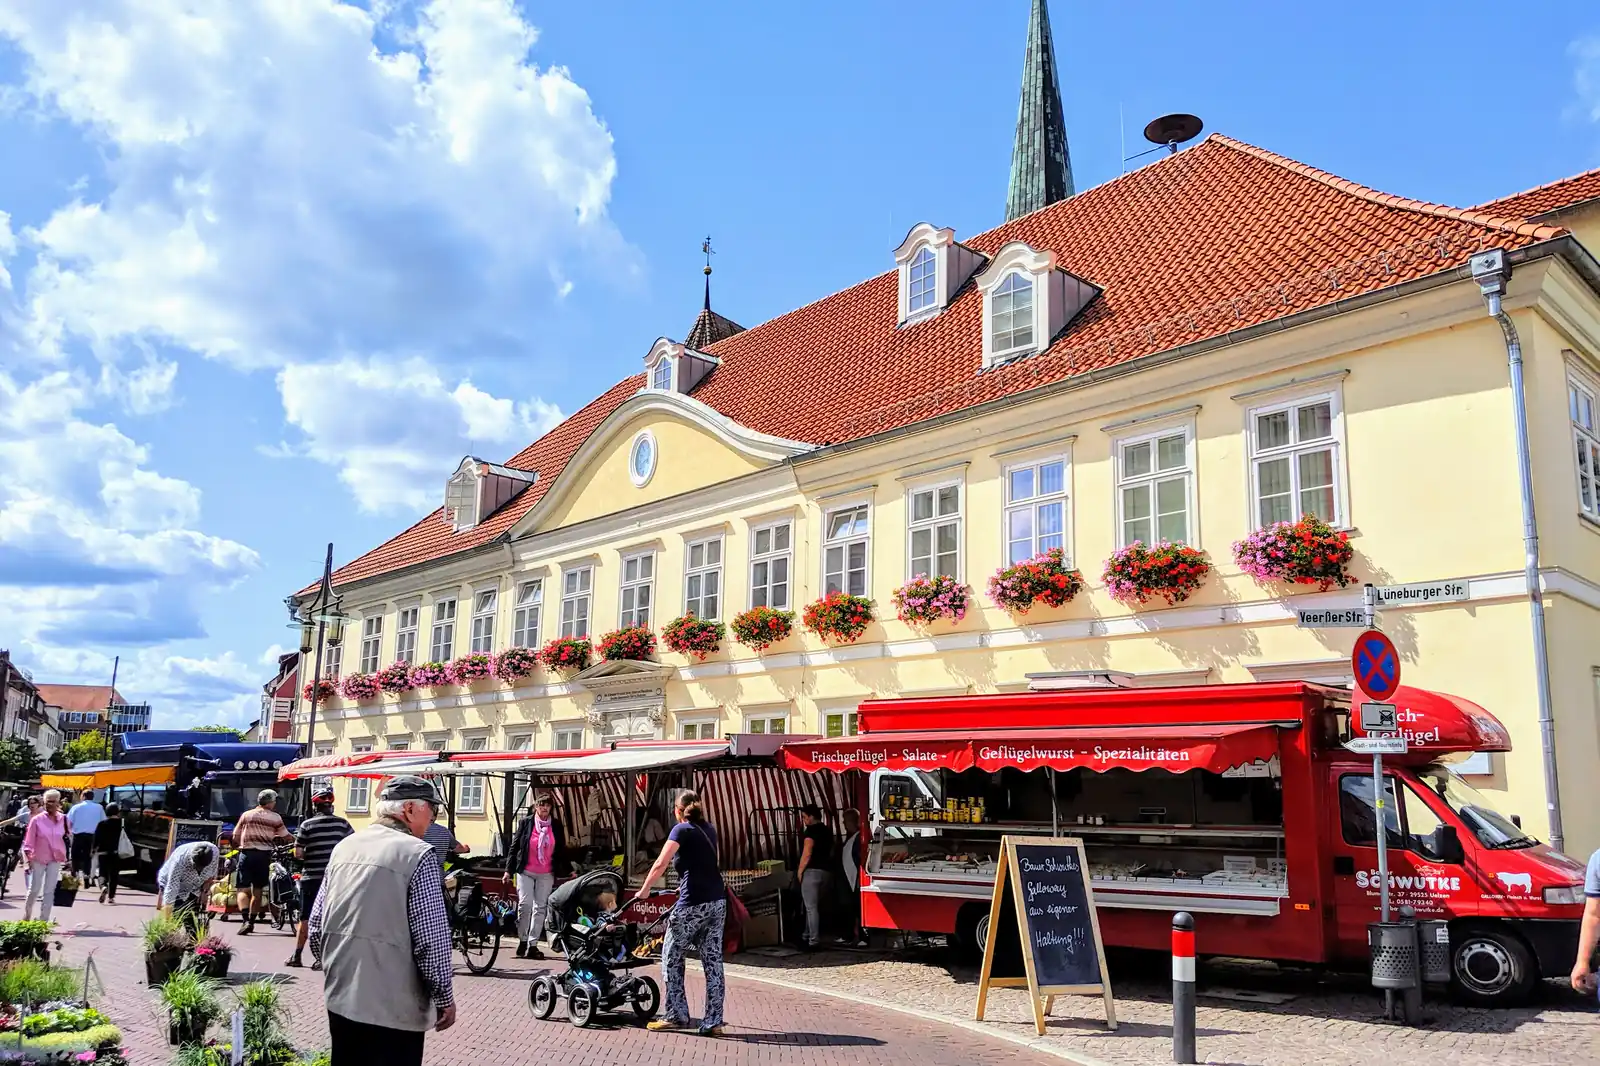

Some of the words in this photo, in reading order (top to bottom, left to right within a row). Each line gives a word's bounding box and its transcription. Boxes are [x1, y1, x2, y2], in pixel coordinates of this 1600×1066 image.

[1377, 586, 1442, 601] Lüneburger
[1445, 584, 1464, 596] Str.
[1299, 611, 1344, 623] Veerßer
[1345, 611, 1364, 623] Str.
[1367, 727, 1440, 746] elügel
[812, 749, 887, 765] Frischgeflügel
[902, 748, 937, 761] Salate
[979, 745, 1074, 762] Geflügelwurst
[1094, 746, 1189, 763] Spezialitäten
[1370, 868, 1393, 876] Bar
[1027, 881, 1067, 902] Galloway
[633, 902, 657, 915] Täglich
[1029, 906, 1044, 916] aus
[1046, 904, 1078, 920] eigener
